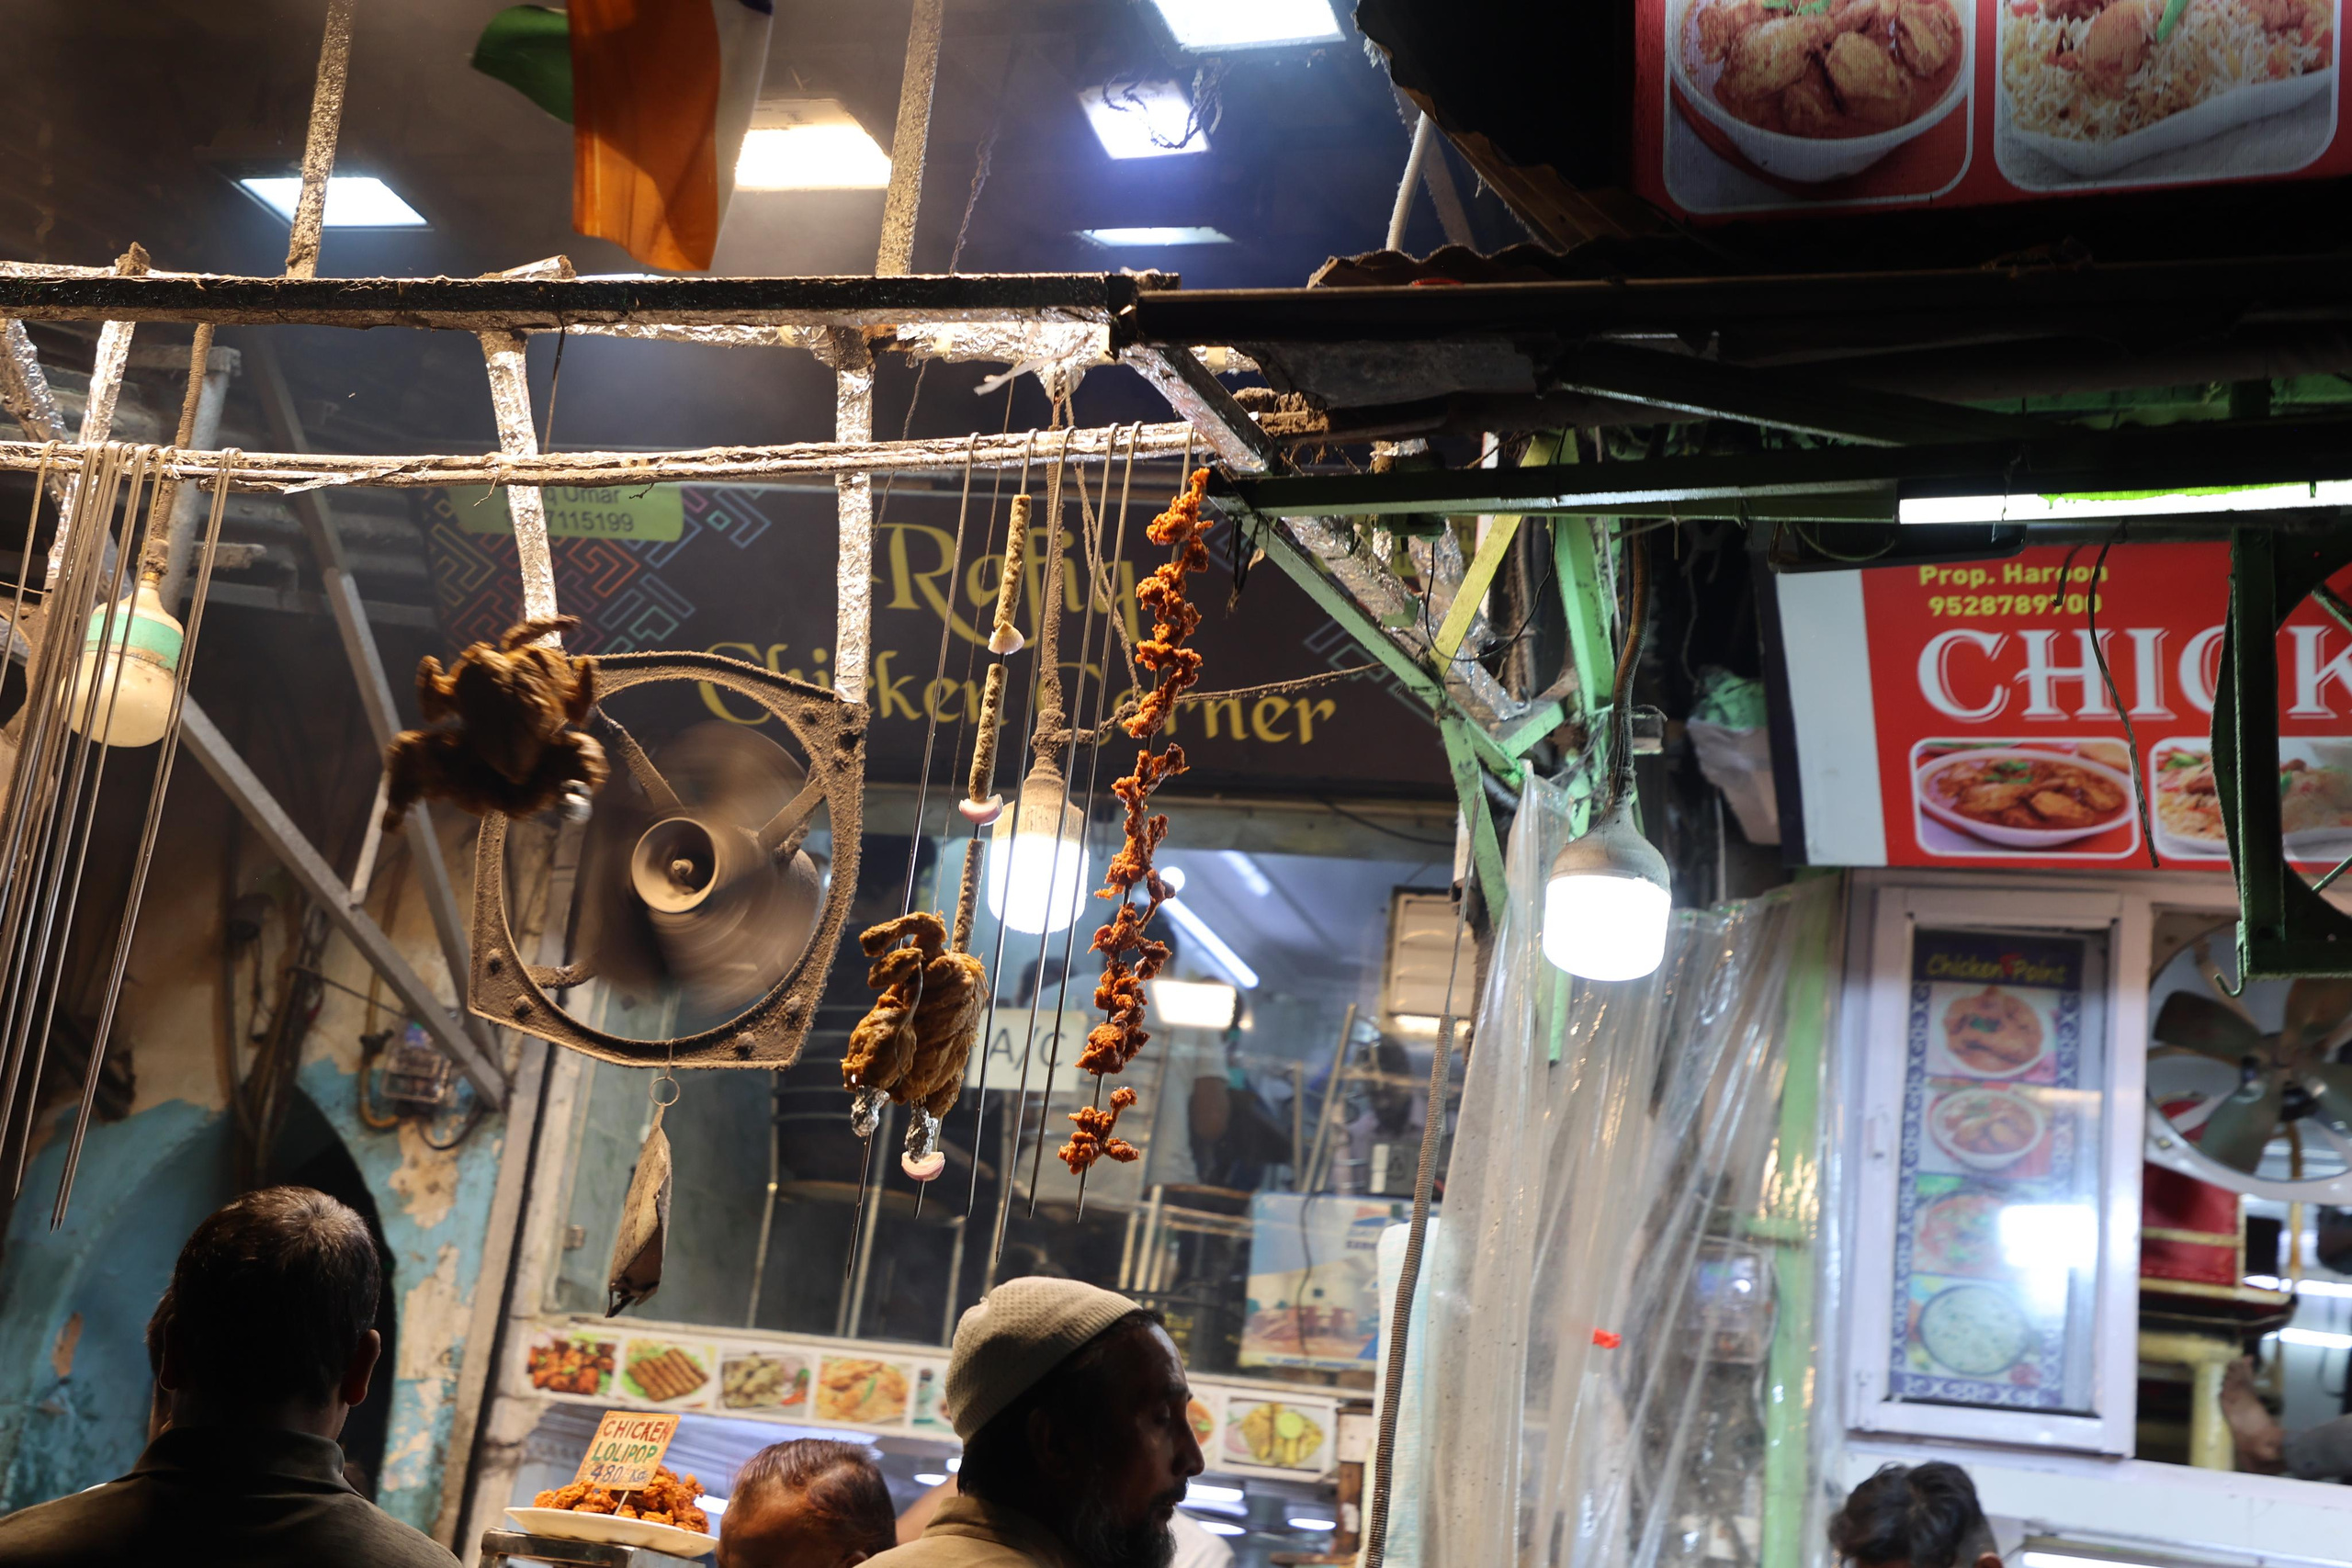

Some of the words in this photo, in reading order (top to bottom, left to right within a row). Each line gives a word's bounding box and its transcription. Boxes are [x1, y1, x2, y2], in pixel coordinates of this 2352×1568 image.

[1918, 564, 1996, 590] Prop.
[603, 1420, 674, 1443] CHICKEN
[591, 1441, 659, 1463] LOLIPOP
